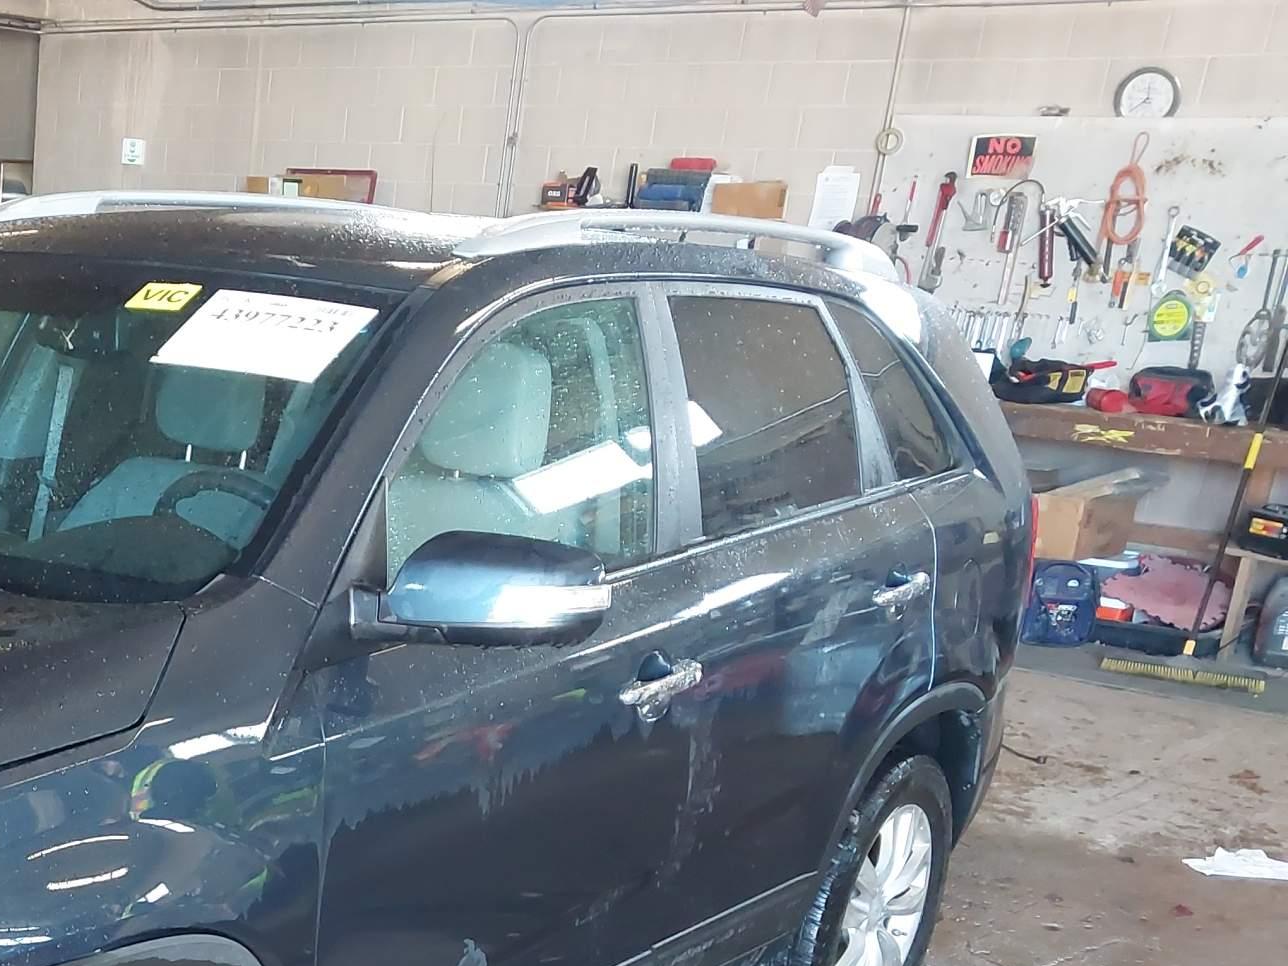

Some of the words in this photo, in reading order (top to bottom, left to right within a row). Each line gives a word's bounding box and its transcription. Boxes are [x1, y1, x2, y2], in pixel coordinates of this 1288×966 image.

[988, 138, 1022, 154] NO
[142, 288, 190, 303] VIC
[210, 308, 340, 333] 43977223
